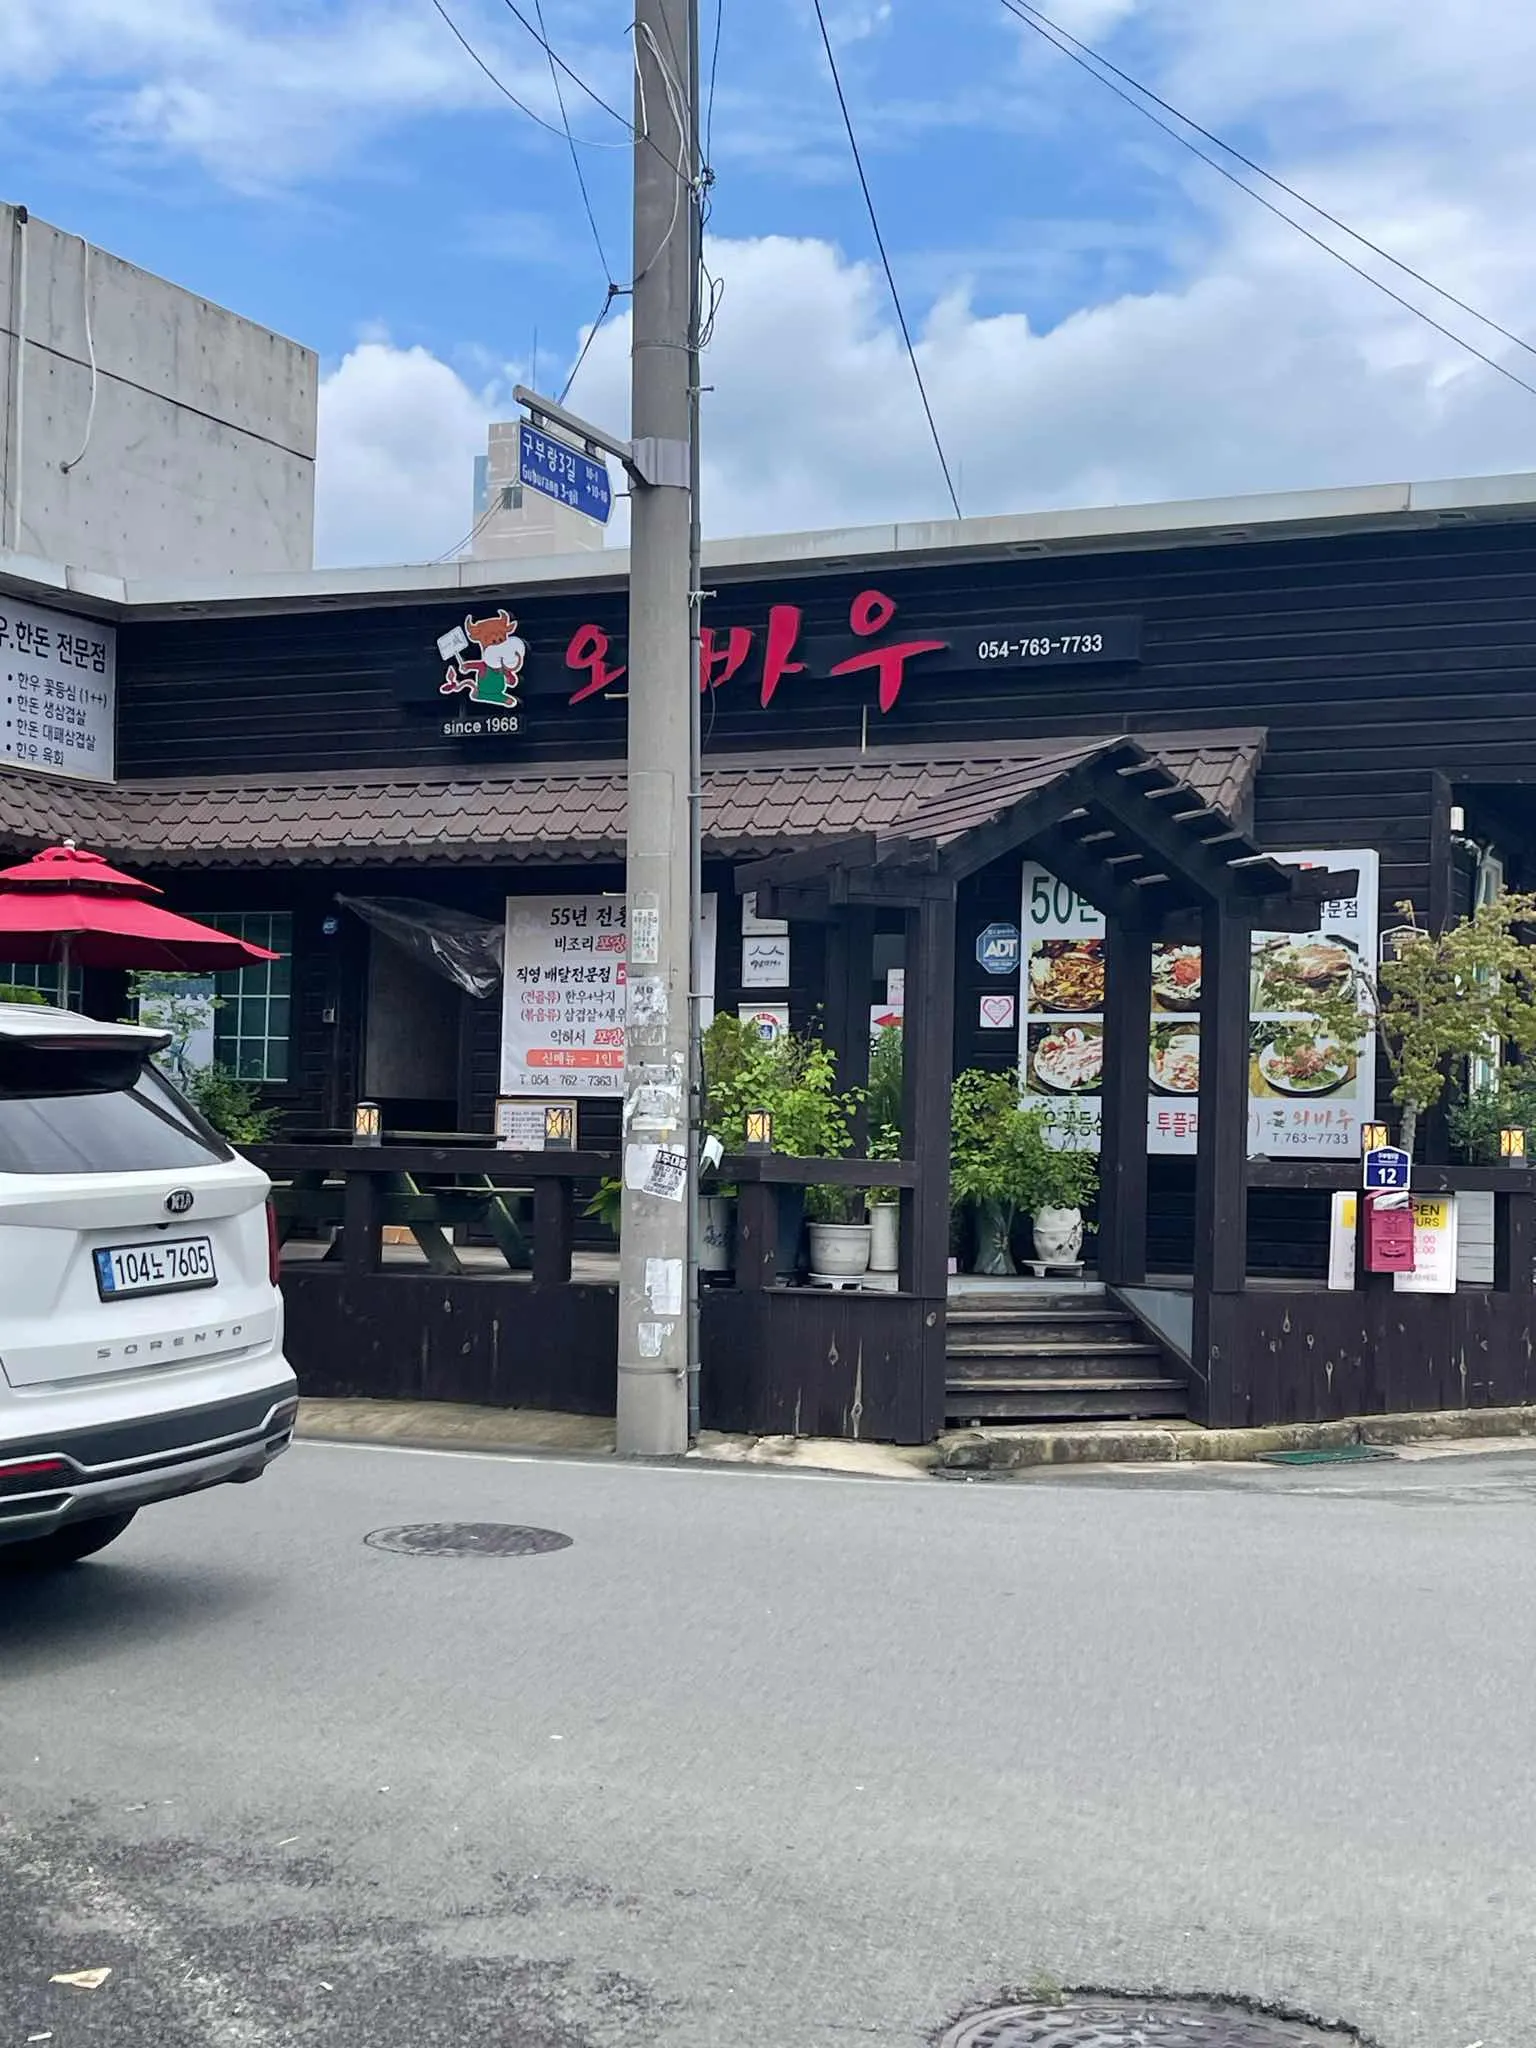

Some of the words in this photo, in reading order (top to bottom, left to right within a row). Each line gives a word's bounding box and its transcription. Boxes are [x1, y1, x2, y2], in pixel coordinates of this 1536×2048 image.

[523, 433, 576, 483] 구부랑3길
[57, 633, 105, 673] 전문점
[978, 634, 1103, 660] 054-763-7733
[18, 672, 40, 692] 한우
[44, 678, 76, 701] 꽃등심
[17, 695, 40, 715] 한돈
[17, 718, 40, 738] 한돈
[443, 720, 481, 734] since
[486, 716, 518, 732] 1968
[16, 742, 39, 760] 한우
[550, 906, 587, 928] 55년
[555, 936, 594, 953] 비조리
[984, 939, 1018, 957] ADT
[517, 966, 540, 984] 직영
[531, 1074, 550, 1086] 054
[560, 1075, 578, 1087] 762
[1378, 1168, 1397, 1184] 12
[171, 1194, 192, 1210] KIA
[1412, 1204, 1440, 1215] PEN
[97, 1326, 242, 1359] SORENTO
